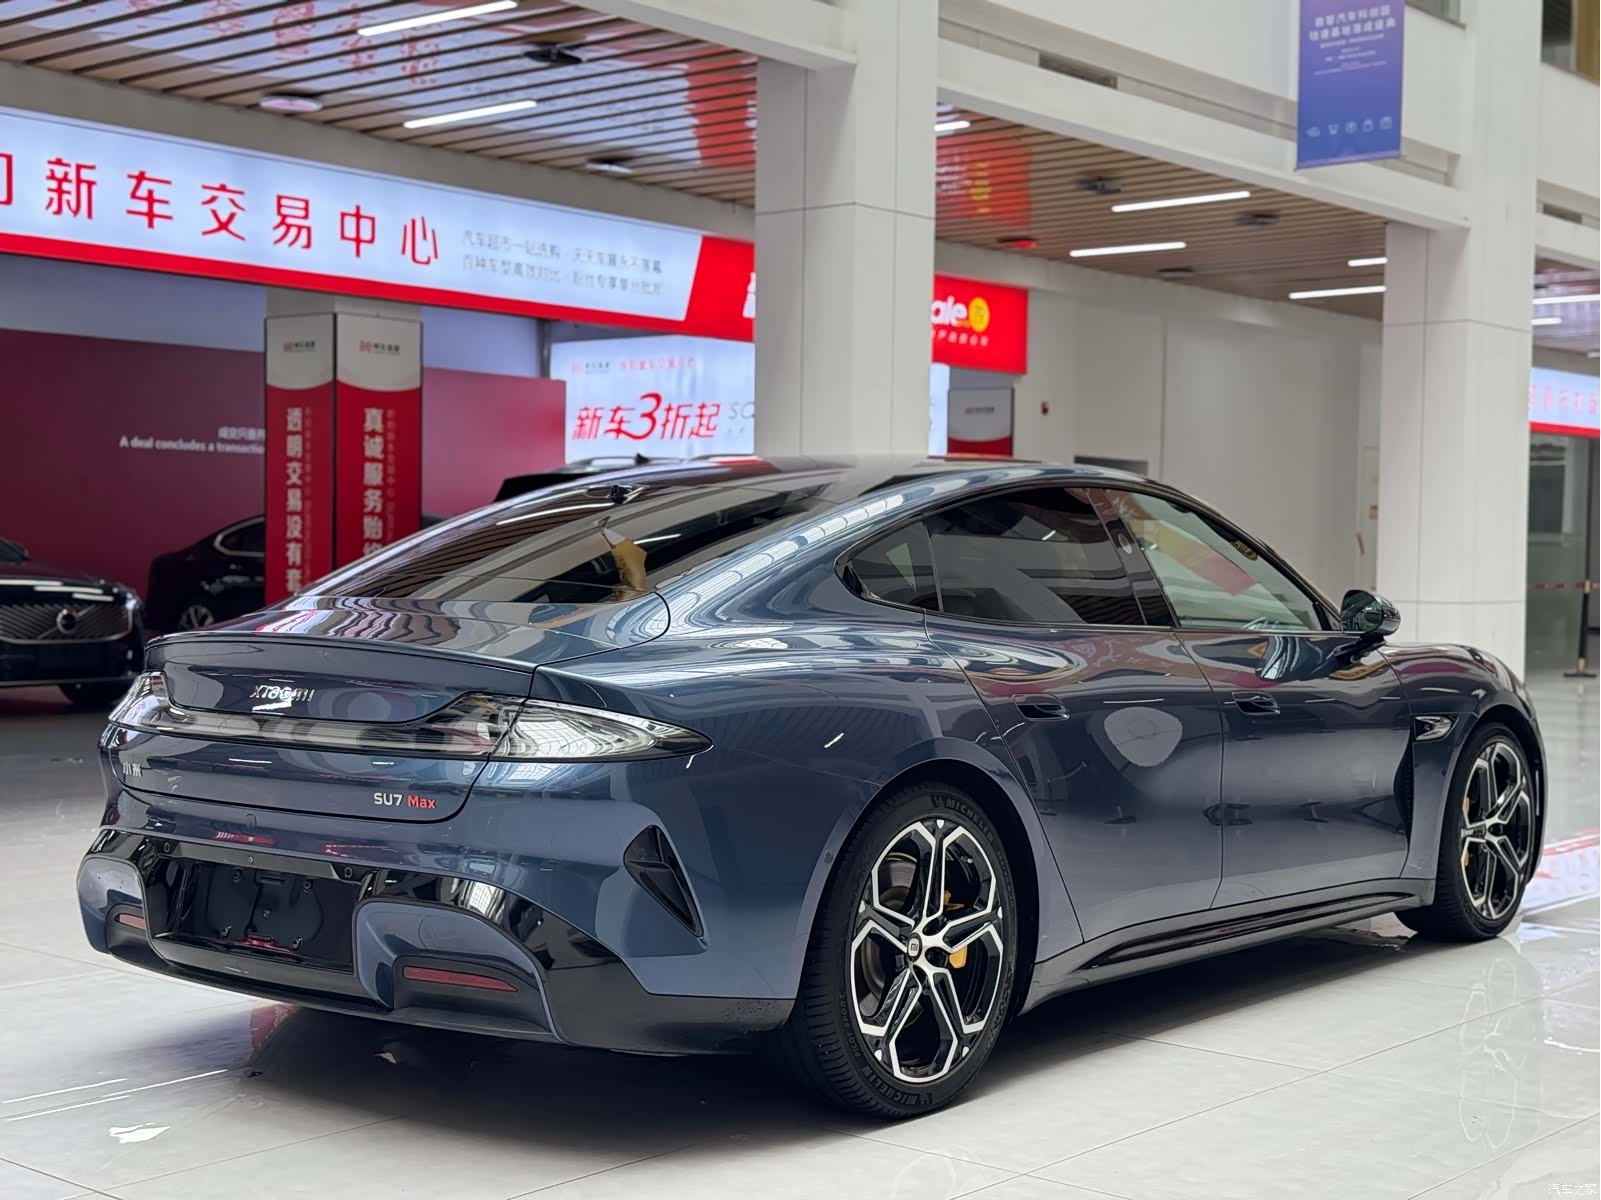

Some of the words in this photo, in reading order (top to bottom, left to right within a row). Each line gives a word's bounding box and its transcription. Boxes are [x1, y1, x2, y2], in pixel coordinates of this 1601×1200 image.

[572, 392, 721, 440] 新车3折起
[119, 435, 129, 448] A
[130, 436, 154, 449] deal
[155, 438, 206, 452] concludes
[207, 442, 215, 452] a
[373, 792, 403, 806] SU7
[407, 795, 436, 809] Max
[946, 798, 994, 842] MICHELIN
[862, 1064, 918, 1105] MICHELIN
